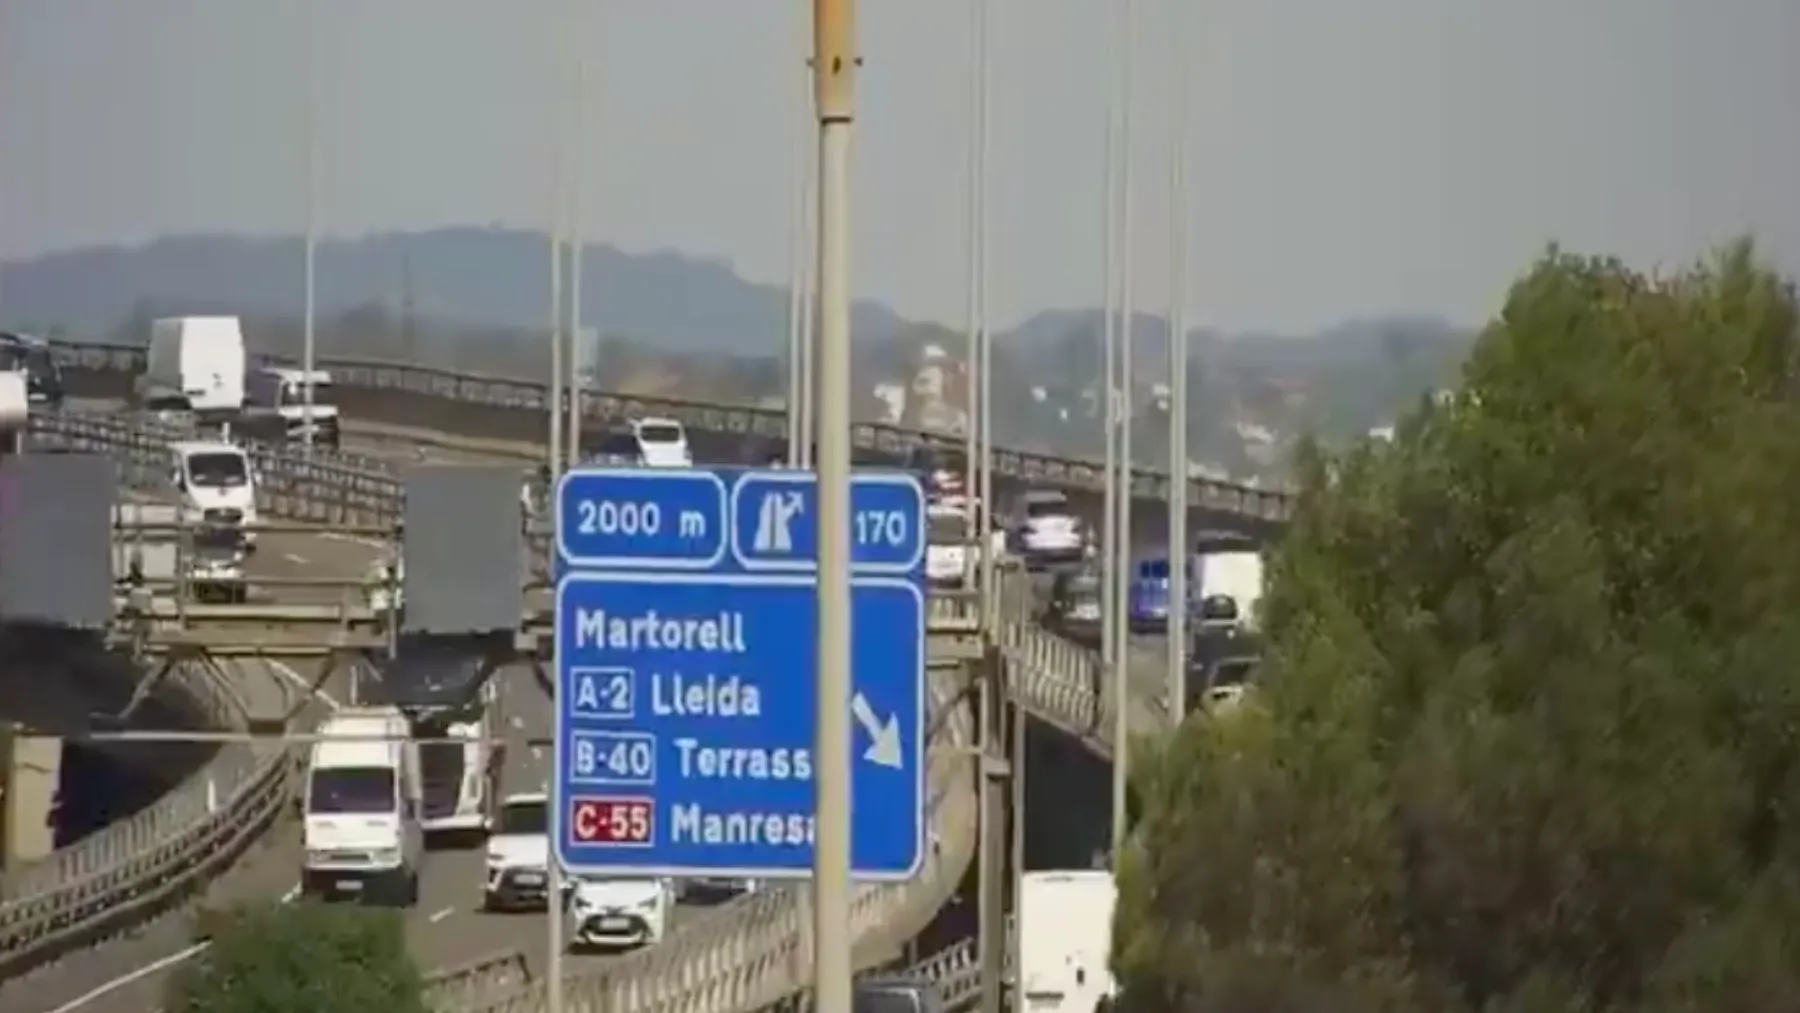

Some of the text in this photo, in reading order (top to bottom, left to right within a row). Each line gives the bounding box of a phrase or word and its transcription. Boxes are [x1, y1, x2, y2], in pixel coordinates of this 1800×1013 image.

[577, 502, 706, 538] 2000 m
[856, 510, 906, 545] 170
[575, 609, 746, 652] Martorell
[576, 673, 761, 716] A-2 Lleida
[575, 738, 812, 780] B-40 Terrass
[575, 806, 650, 839] C-55
